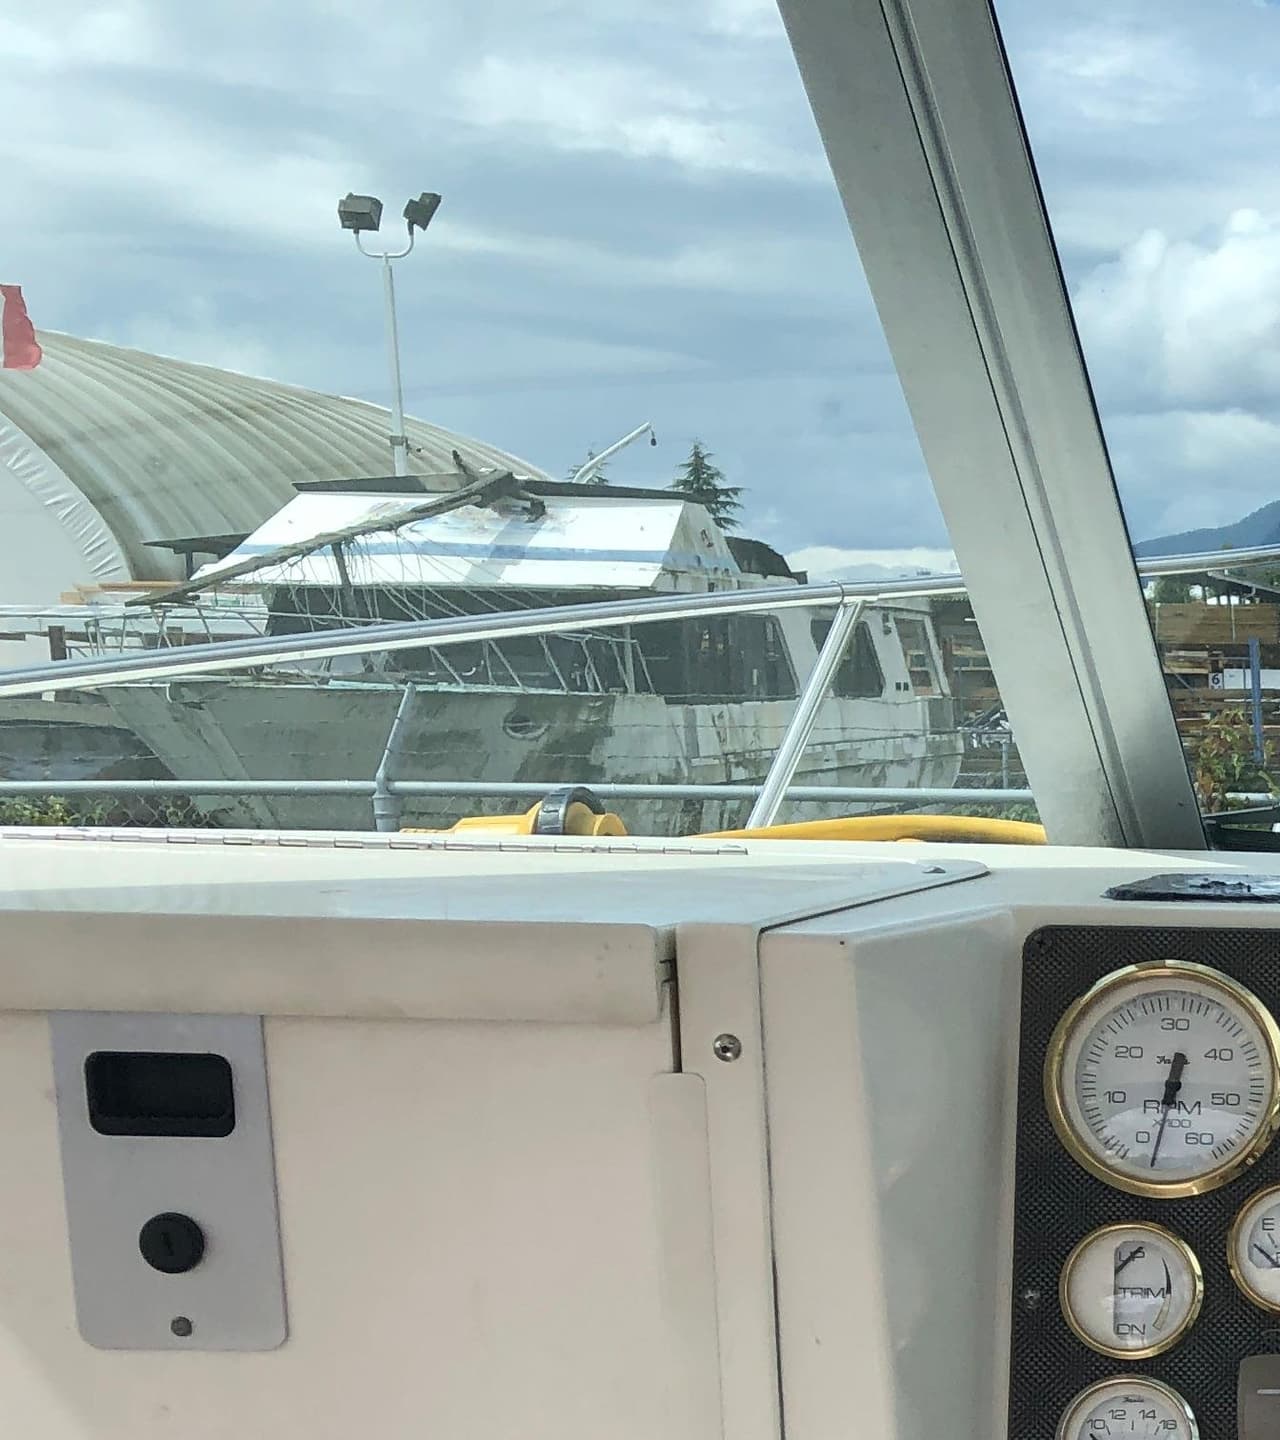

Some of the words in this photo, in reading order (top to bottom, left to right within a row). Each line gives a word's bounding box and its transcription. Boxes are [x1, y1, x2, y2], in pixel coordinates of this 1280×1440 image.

[1161, 1018, 1190, 1031] 30
[1115, 1046, 1143, 1058] 20
[1204, 1048, 1233, 1061] 40
[1104, 1091, 1126, 1104] 10
[1211, 1093, 1240, 1106] 50
[1136, 1131, 1150, 1144] 0
[1185, 1133, 1214, 1145] 60
[1262, 1218, 1275, 1231] E
[1118, 1250, 1146, 1262] UP
[1118, 1287, 1166, 1299] TRIM
[1116, 1324, 1146, 1336] DN
[1108, 1410, 1127, 1421] 12
[1139, 1410, 1157, 1420] 14
[1086, 1419, 1106, 1430] 10
